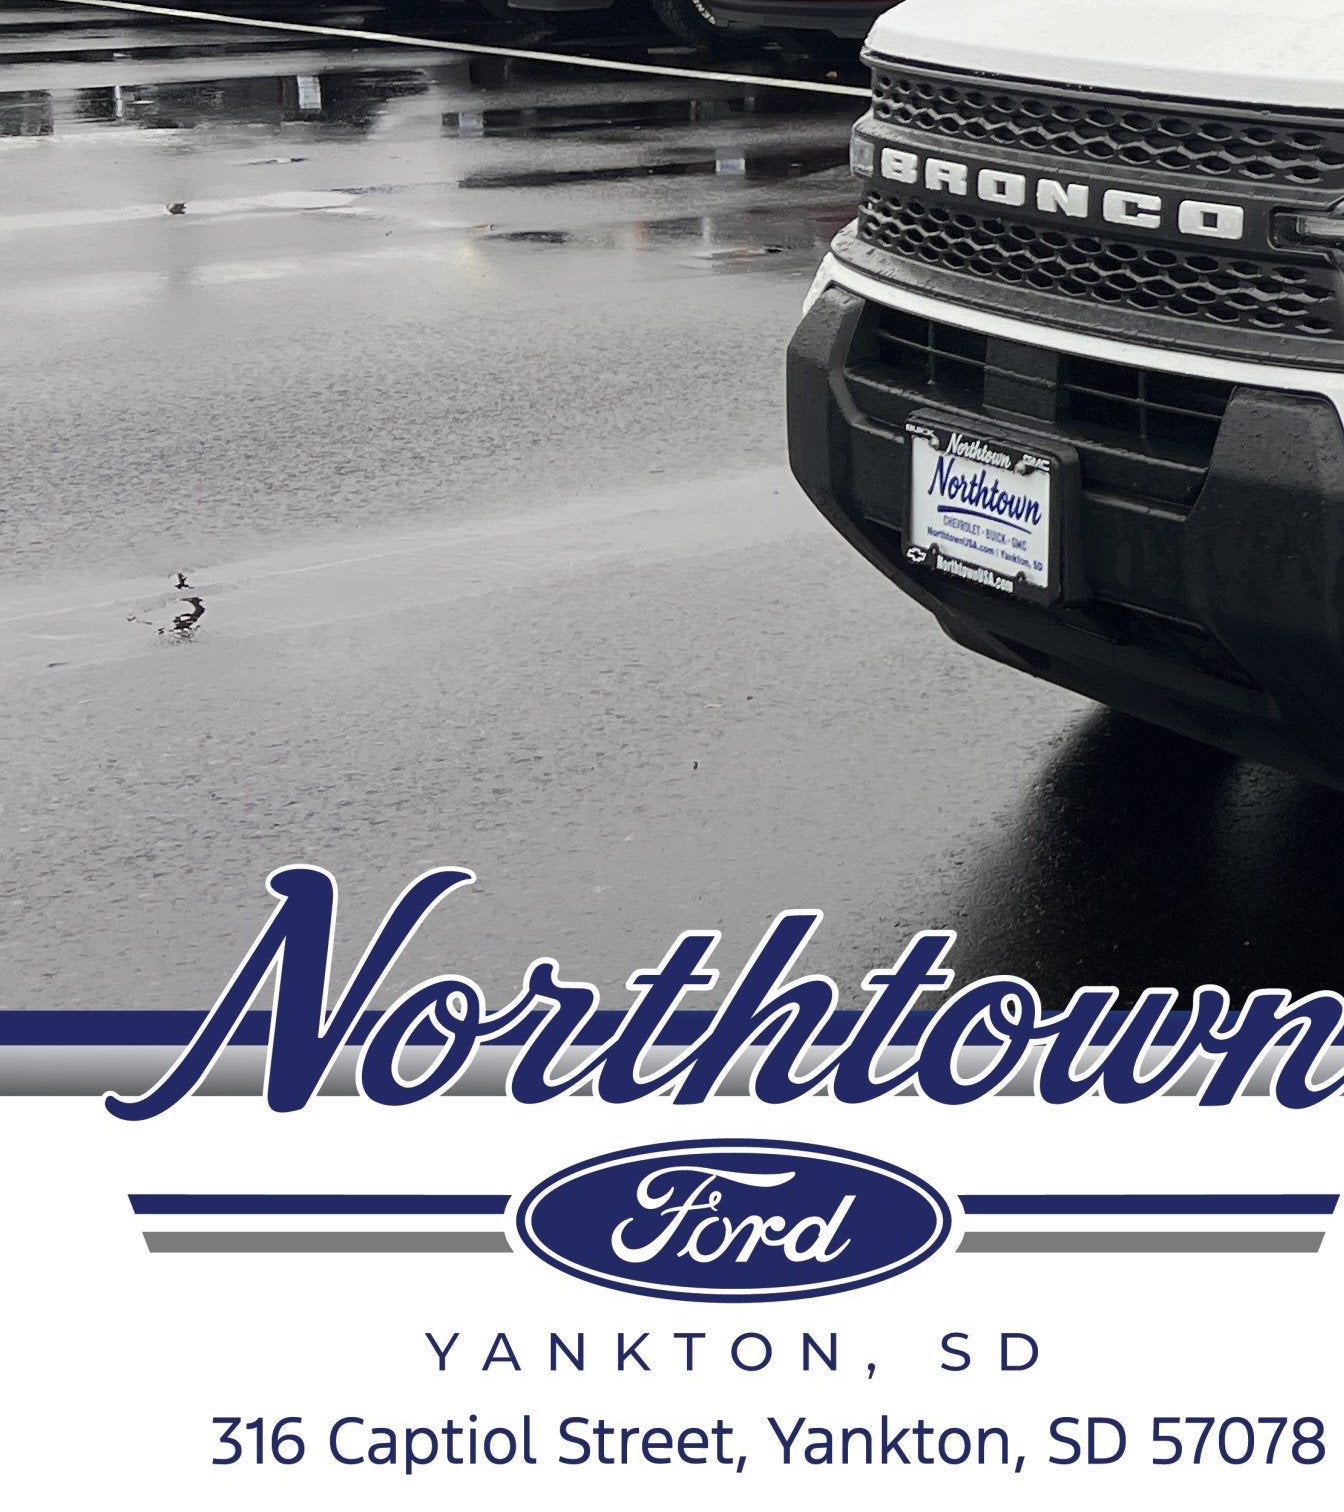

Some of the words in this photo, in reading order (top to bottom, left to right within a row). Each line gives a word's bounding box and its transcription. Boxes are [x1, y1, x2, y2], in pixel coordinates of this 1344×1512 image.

[881, 147, 1243, 239] BRONCO
[946, 433, 1011, 469] Northtown
[928, 455, 1042, 525] Northtown
[927, 525, 995, 556] NorthtownUSA.com
[943, 514, 981, 536] CHEVROLET
[937, 555, 1014, 593] NorthtownUSA.com
